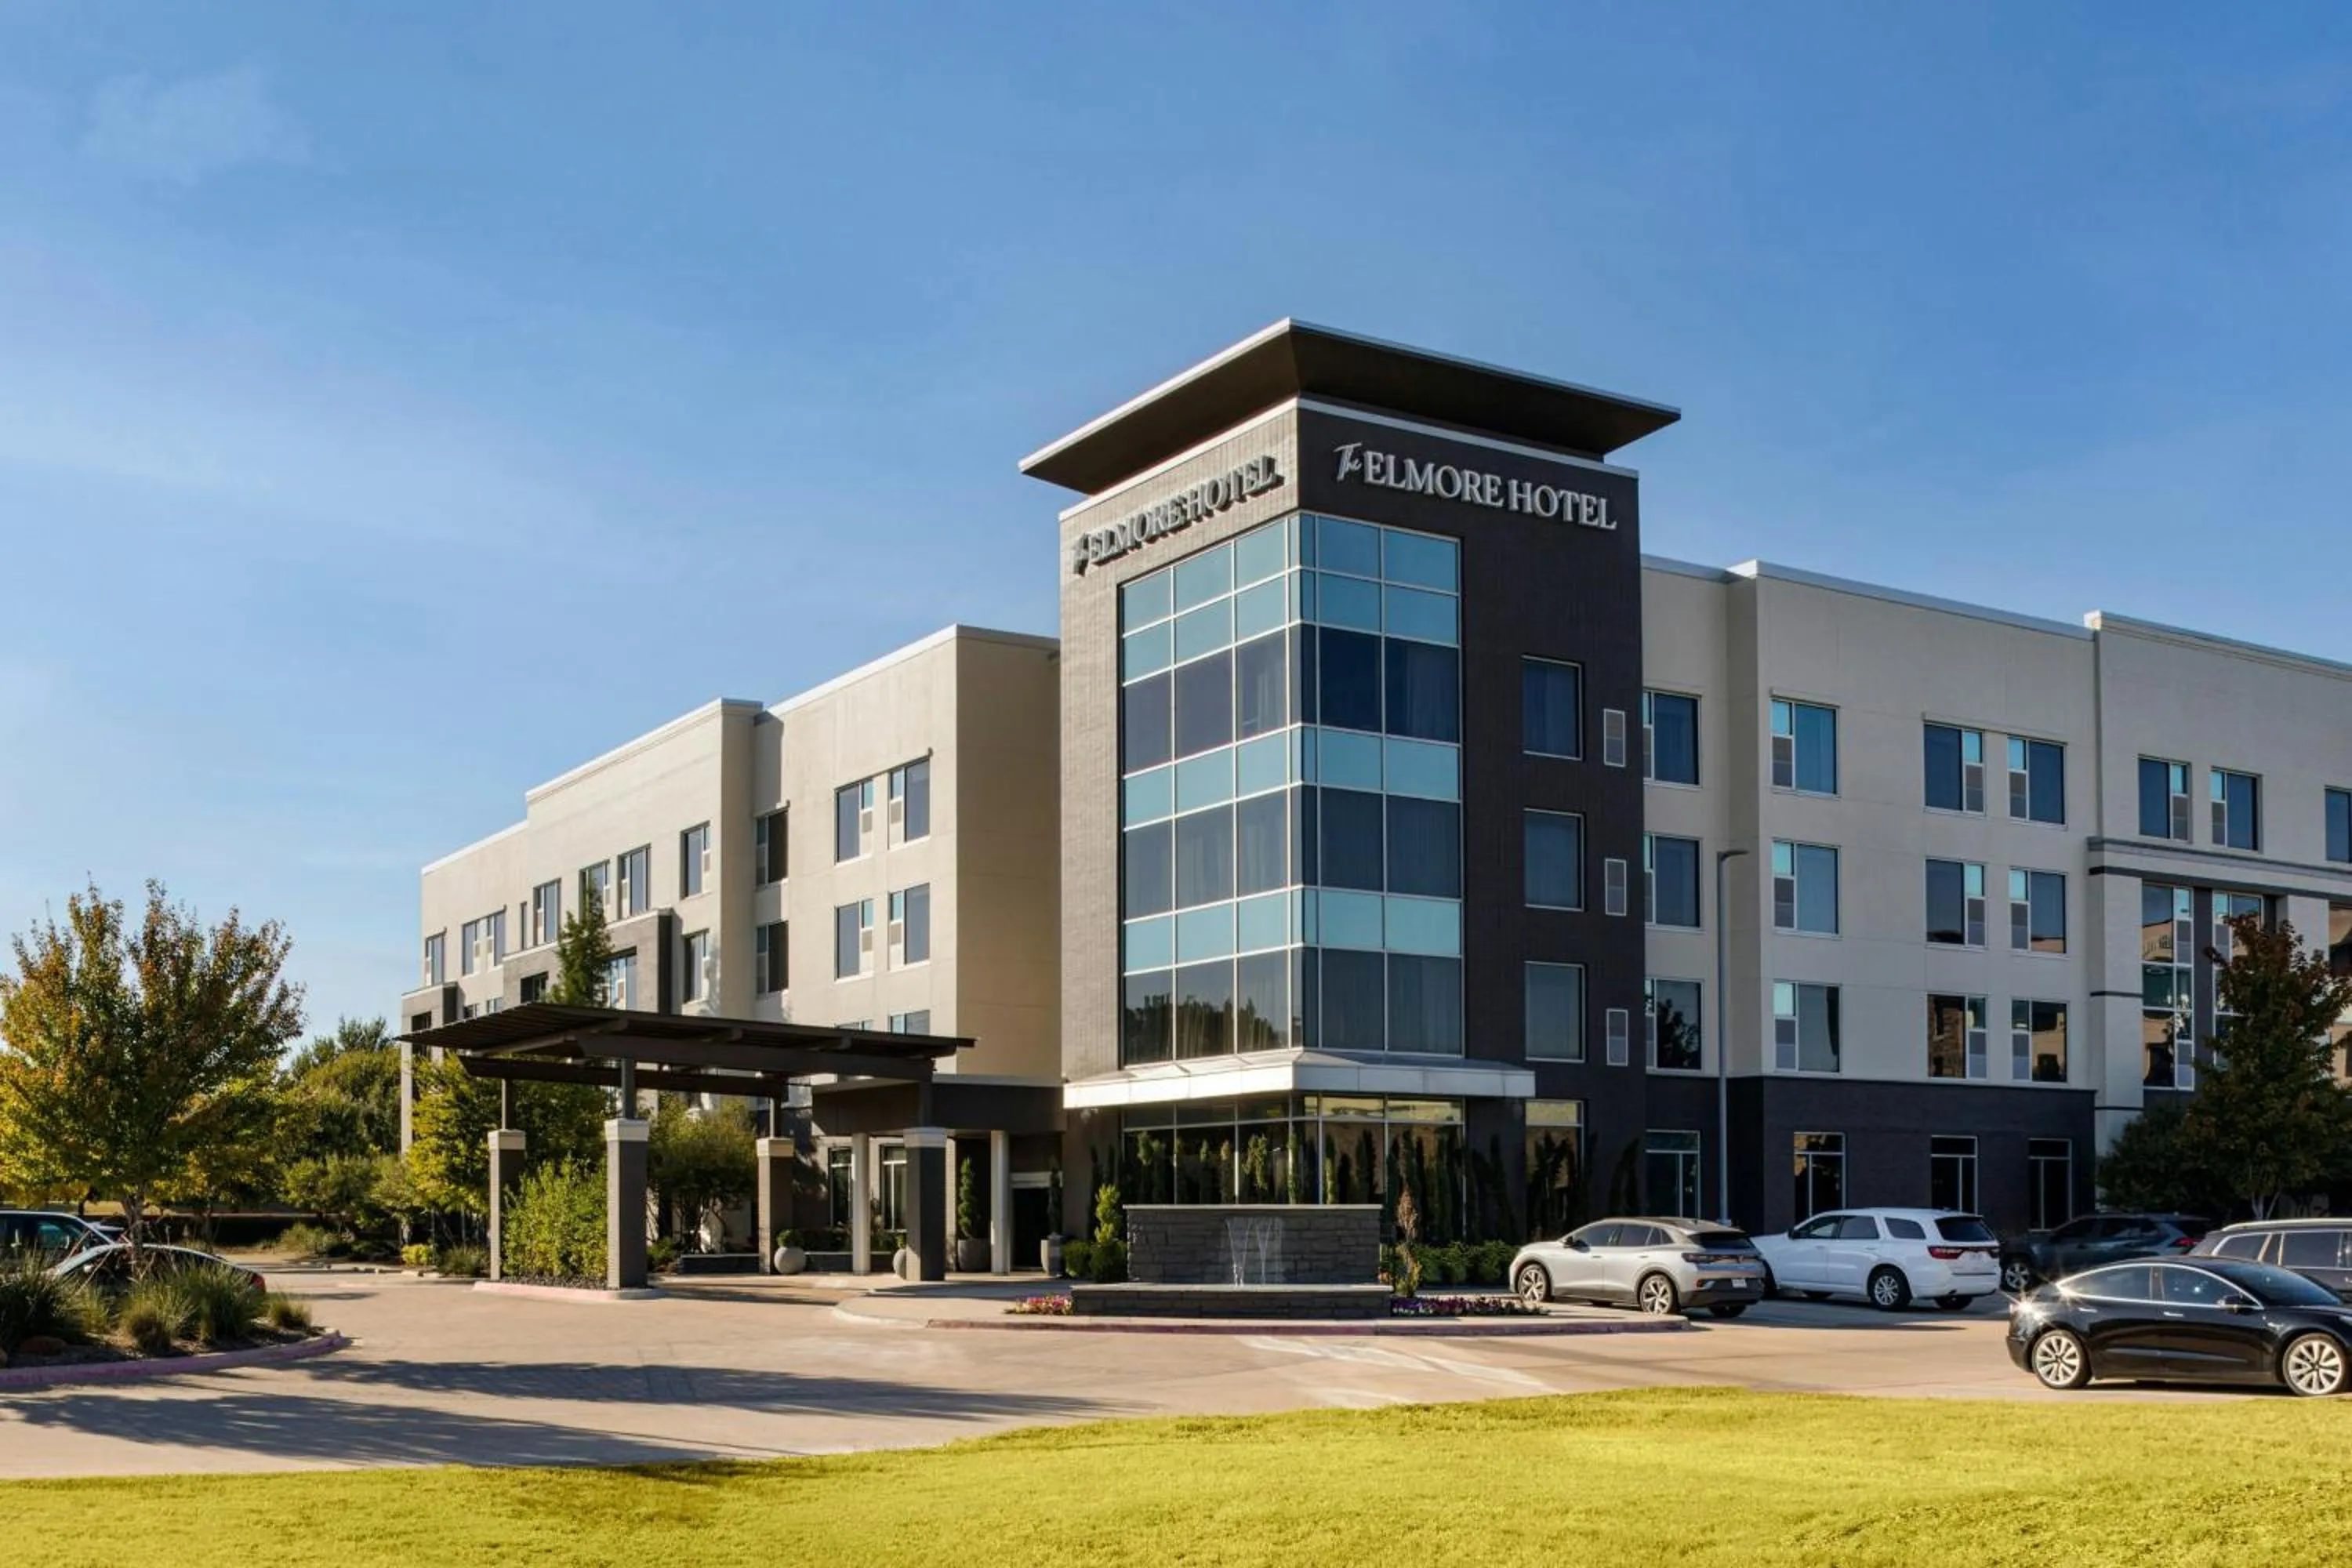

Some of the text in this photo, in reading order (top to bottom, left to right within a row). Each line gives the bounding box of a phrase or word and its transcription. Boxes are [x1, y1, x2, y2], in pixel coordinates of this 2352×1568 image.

[1087, 495, 1188, 561] ELMORE
[1186, 455, 1283, 521] HOTEL
[1334, 442, 1617, 530] The ELMORE HOTEL
